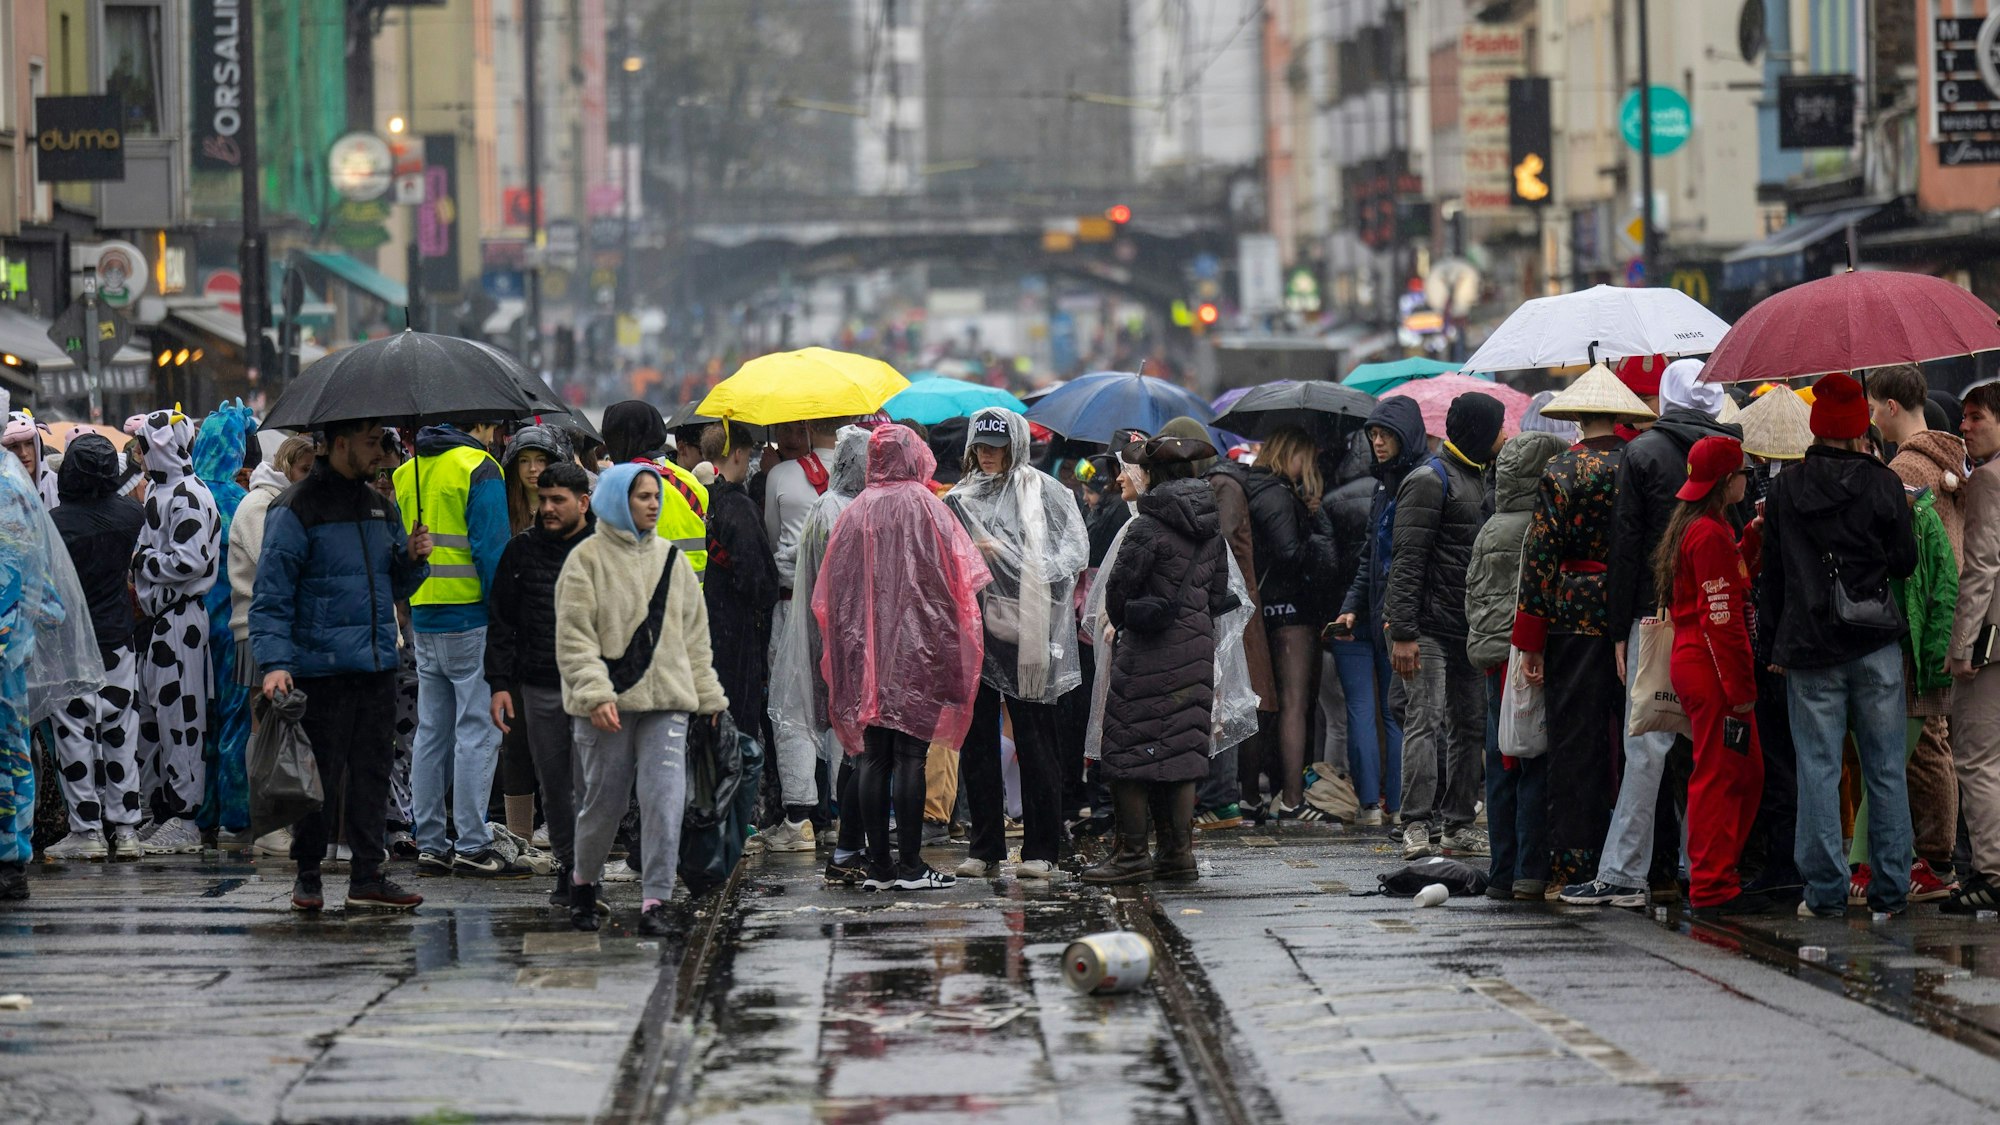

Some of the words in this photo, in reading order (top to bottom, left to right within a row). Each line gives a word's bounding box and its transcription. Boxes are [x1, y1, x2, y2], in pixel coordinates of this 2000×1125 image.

[1939, 20, 1960, 41] M
[1941, 50, 1958, 72] T
[1941, 80, 1960, 103] C
[974, 419, 1007, 433] POLICE
